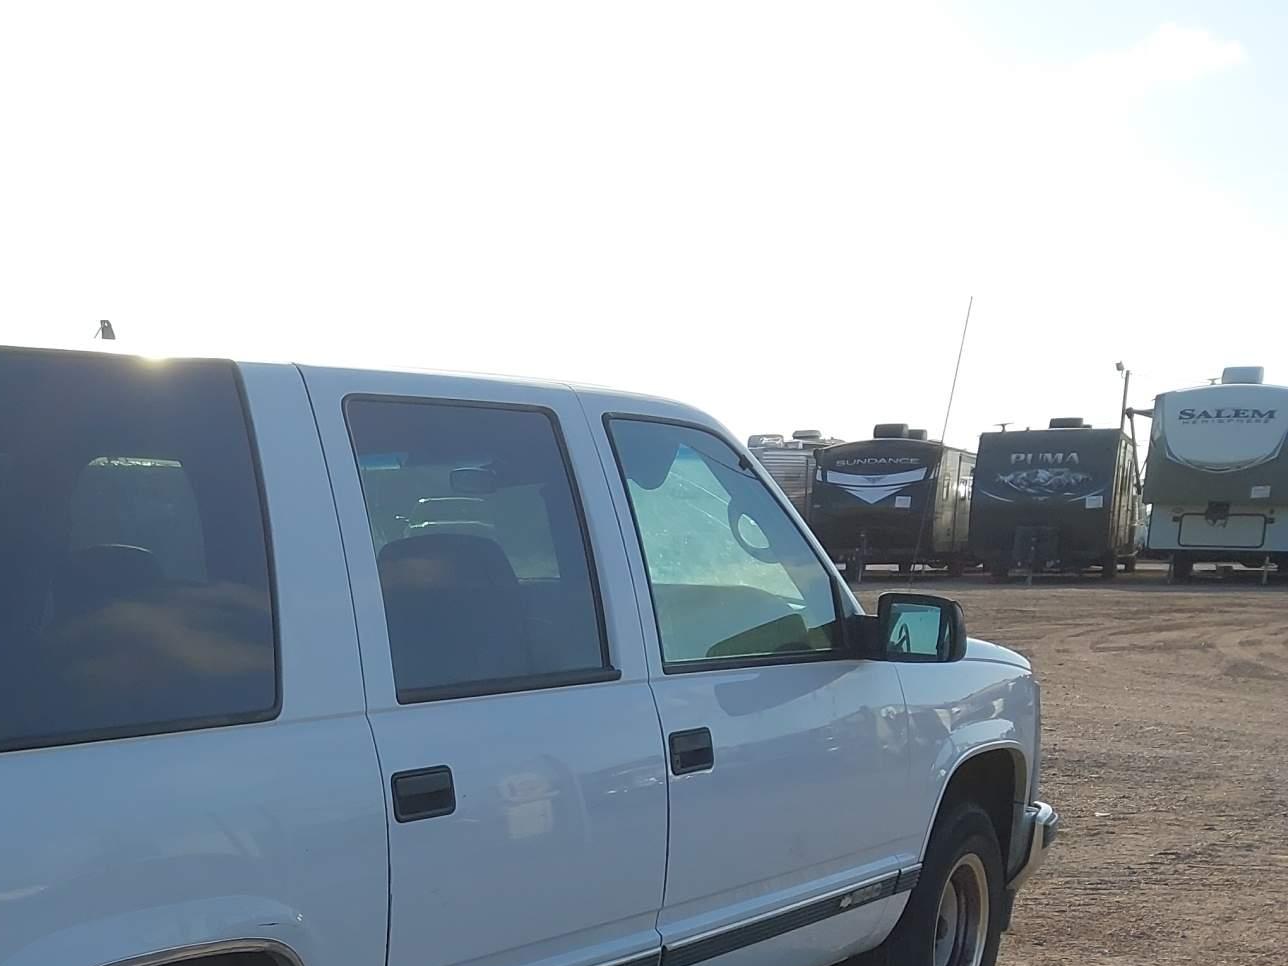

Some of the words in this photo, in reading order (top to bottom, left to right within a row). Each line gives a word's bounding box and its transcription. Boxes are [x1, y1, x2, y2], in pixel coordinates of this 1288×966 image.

[1178, 408, 1277, 420] SALEM
[836, 457, 920, 466] SUNDANCE
[1010, 452, 1080, 465] PUMA
